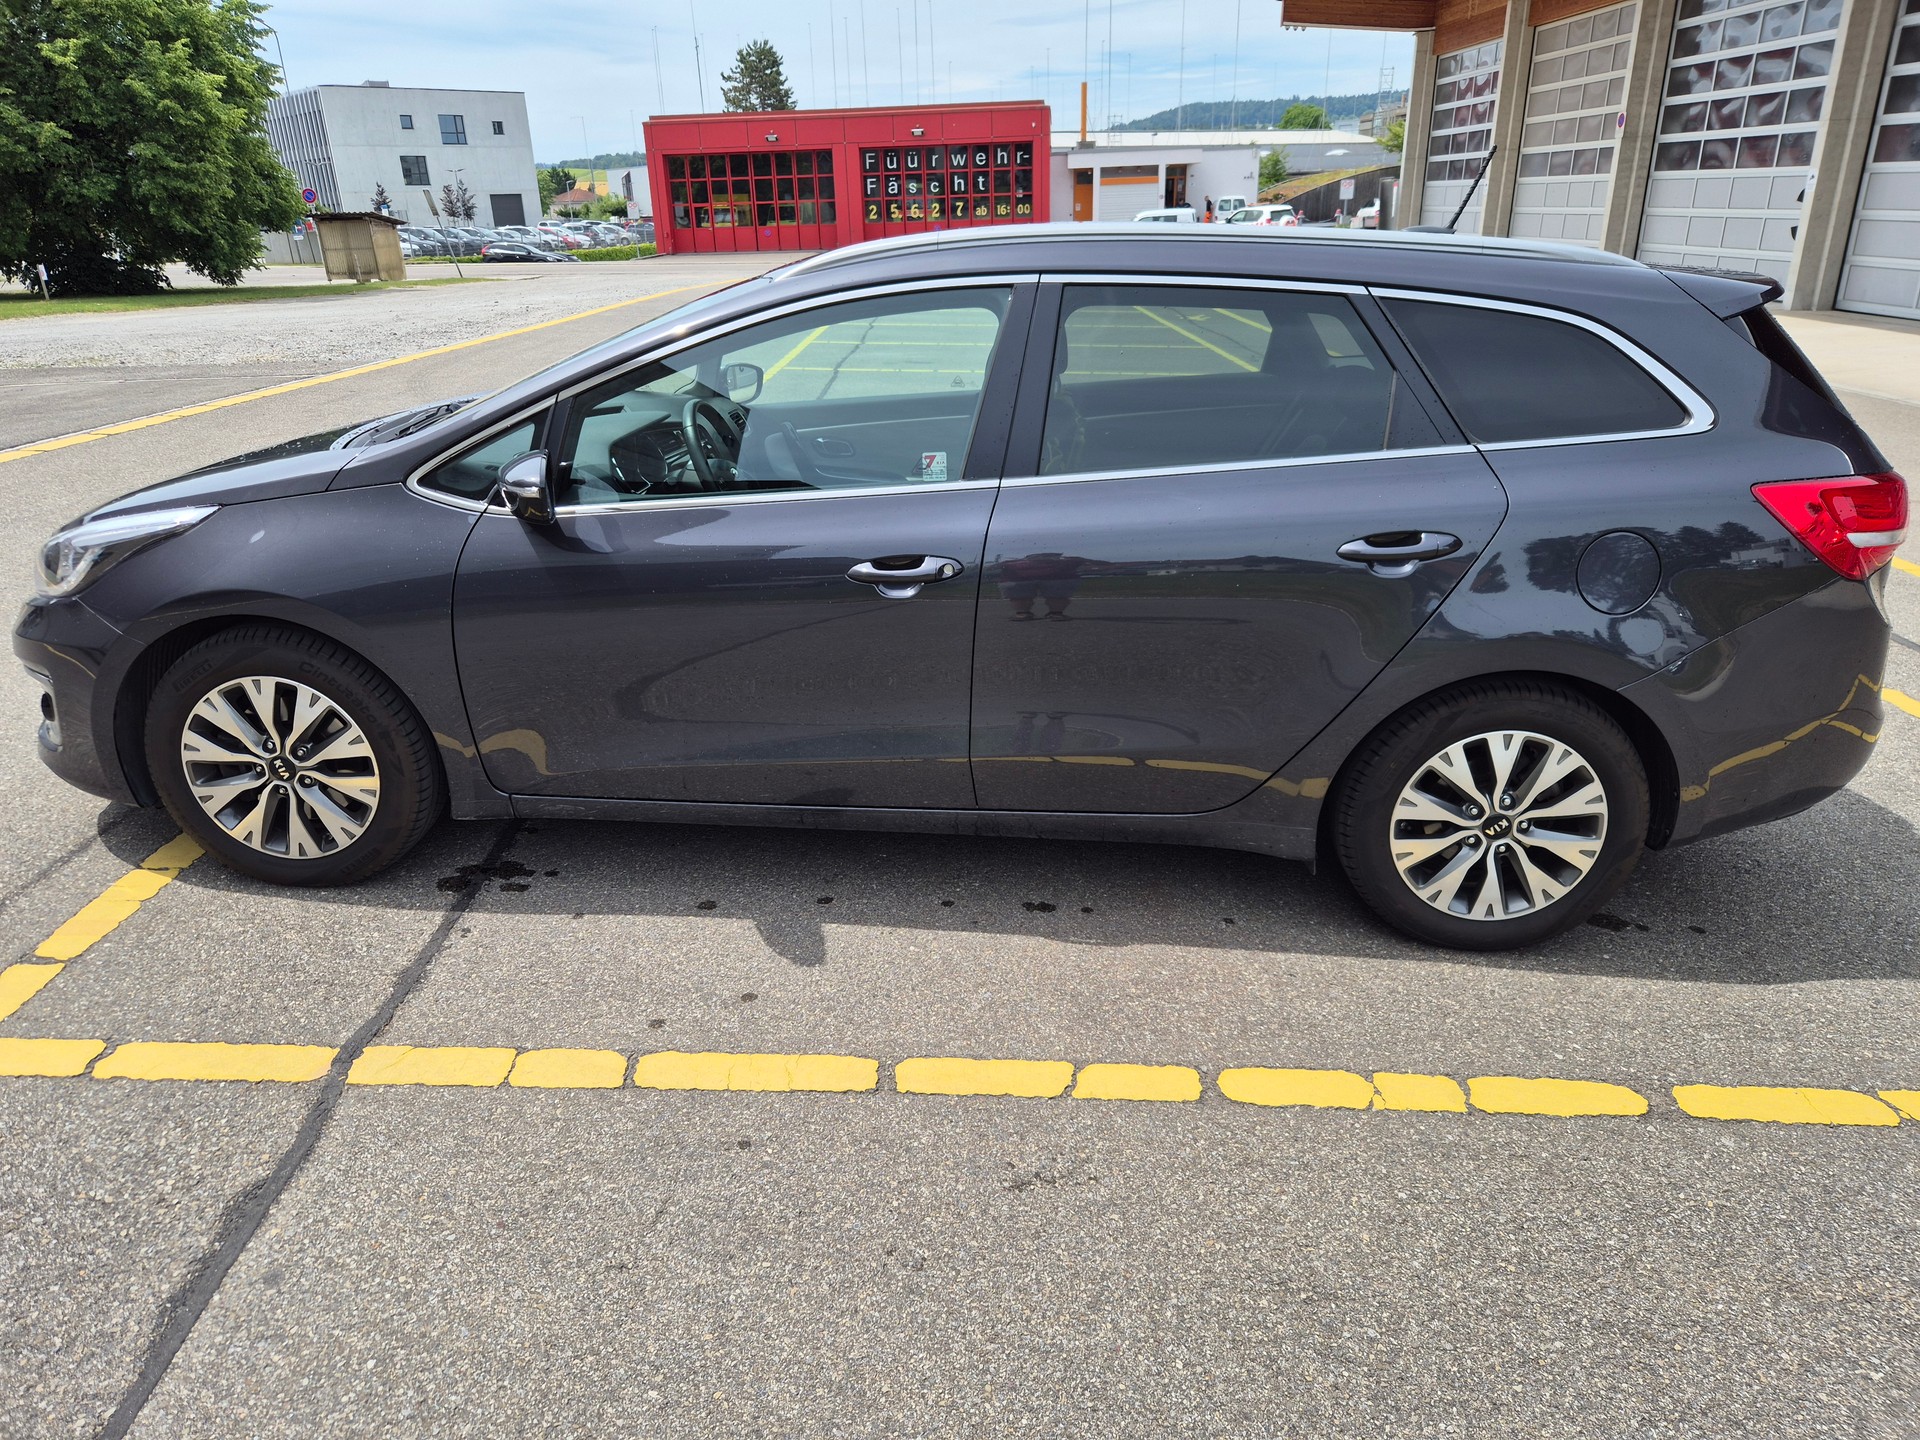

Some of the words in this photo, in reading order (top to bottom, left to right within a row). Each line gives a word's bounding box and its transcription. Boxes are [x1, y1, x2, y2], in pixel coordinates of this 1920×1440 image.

[866, 175, 985, 195] Fäscht
[975, 205, 987, 216] ab
[997, 203, 1031, 216] 16:00
[273, 759, 290, 781] KIA
[1485, 819, 1509, 837] KIA
